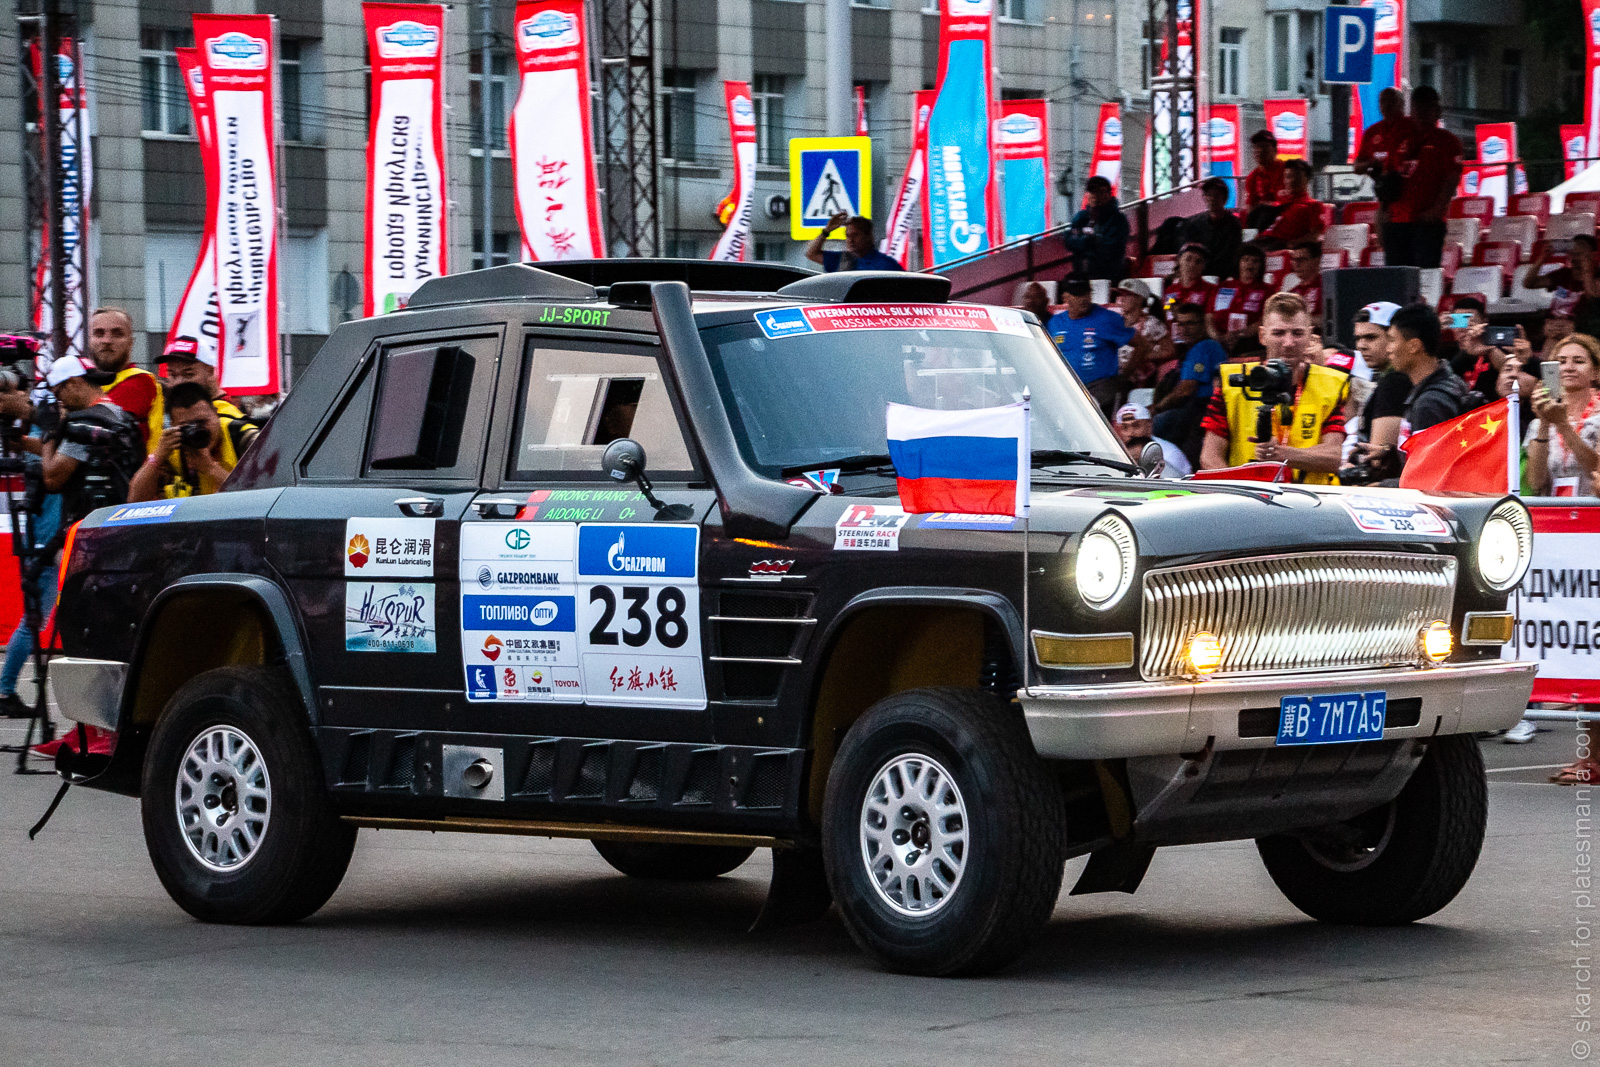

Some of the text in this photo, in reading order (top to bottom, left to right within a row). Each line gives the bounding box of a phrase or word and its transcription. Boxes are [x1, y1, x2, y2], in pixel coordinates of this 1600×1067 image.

[1338, 15, 1367, 74] P
[539, 307, 611, 326] JJ-SPORT
[807, 307, 988, 319] INTERNATIONAL SILK WAY RALLY 2019
[548, 490, 592, 501] YIRONG
[592, 490, 629, 502] WANG
[107, 504, 177, 521] LANDSAIL
[544, 507, 592, 520] AIDONG
[591, 507, 605, 520] LI
[1390, 519, 1415, 530] 238
[875, 530, 897, 538] RACK
[375, 538, 432, 556] 昆仑润滑
[398, 557, 431, 567] Lubricating
[624, 556, 666, 573] GAZPROM
[497, 572, 560, 584] GAZPROMBANK
[479, 605, 553, 620] ТОПЛИВО ОПТИ
[589, 584, 688, 648] 238
[609, 665, 679, 692] 红旗小镇
